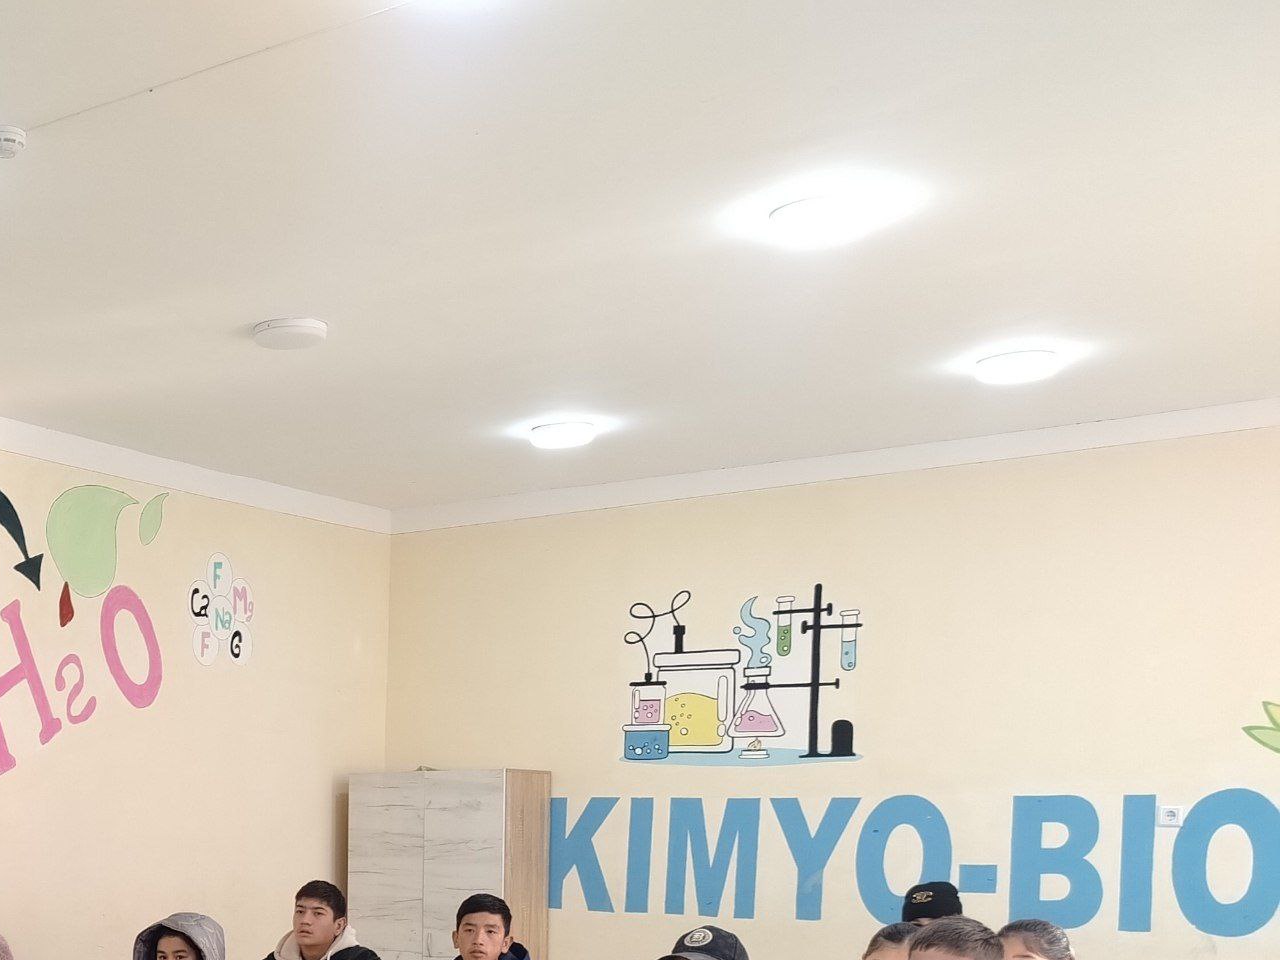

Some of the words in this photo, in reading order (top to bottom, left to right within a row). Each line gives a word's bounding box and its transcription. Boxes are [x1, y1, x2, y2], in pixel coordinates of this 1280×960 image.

[213, 561, 223, 589] F
[232, 585, 254, 623] Mg
[214, 607, 232, 631] Na
[200, 631, 211, 658] F
[548, 787, 1280, 938] KIMYO-BIO
